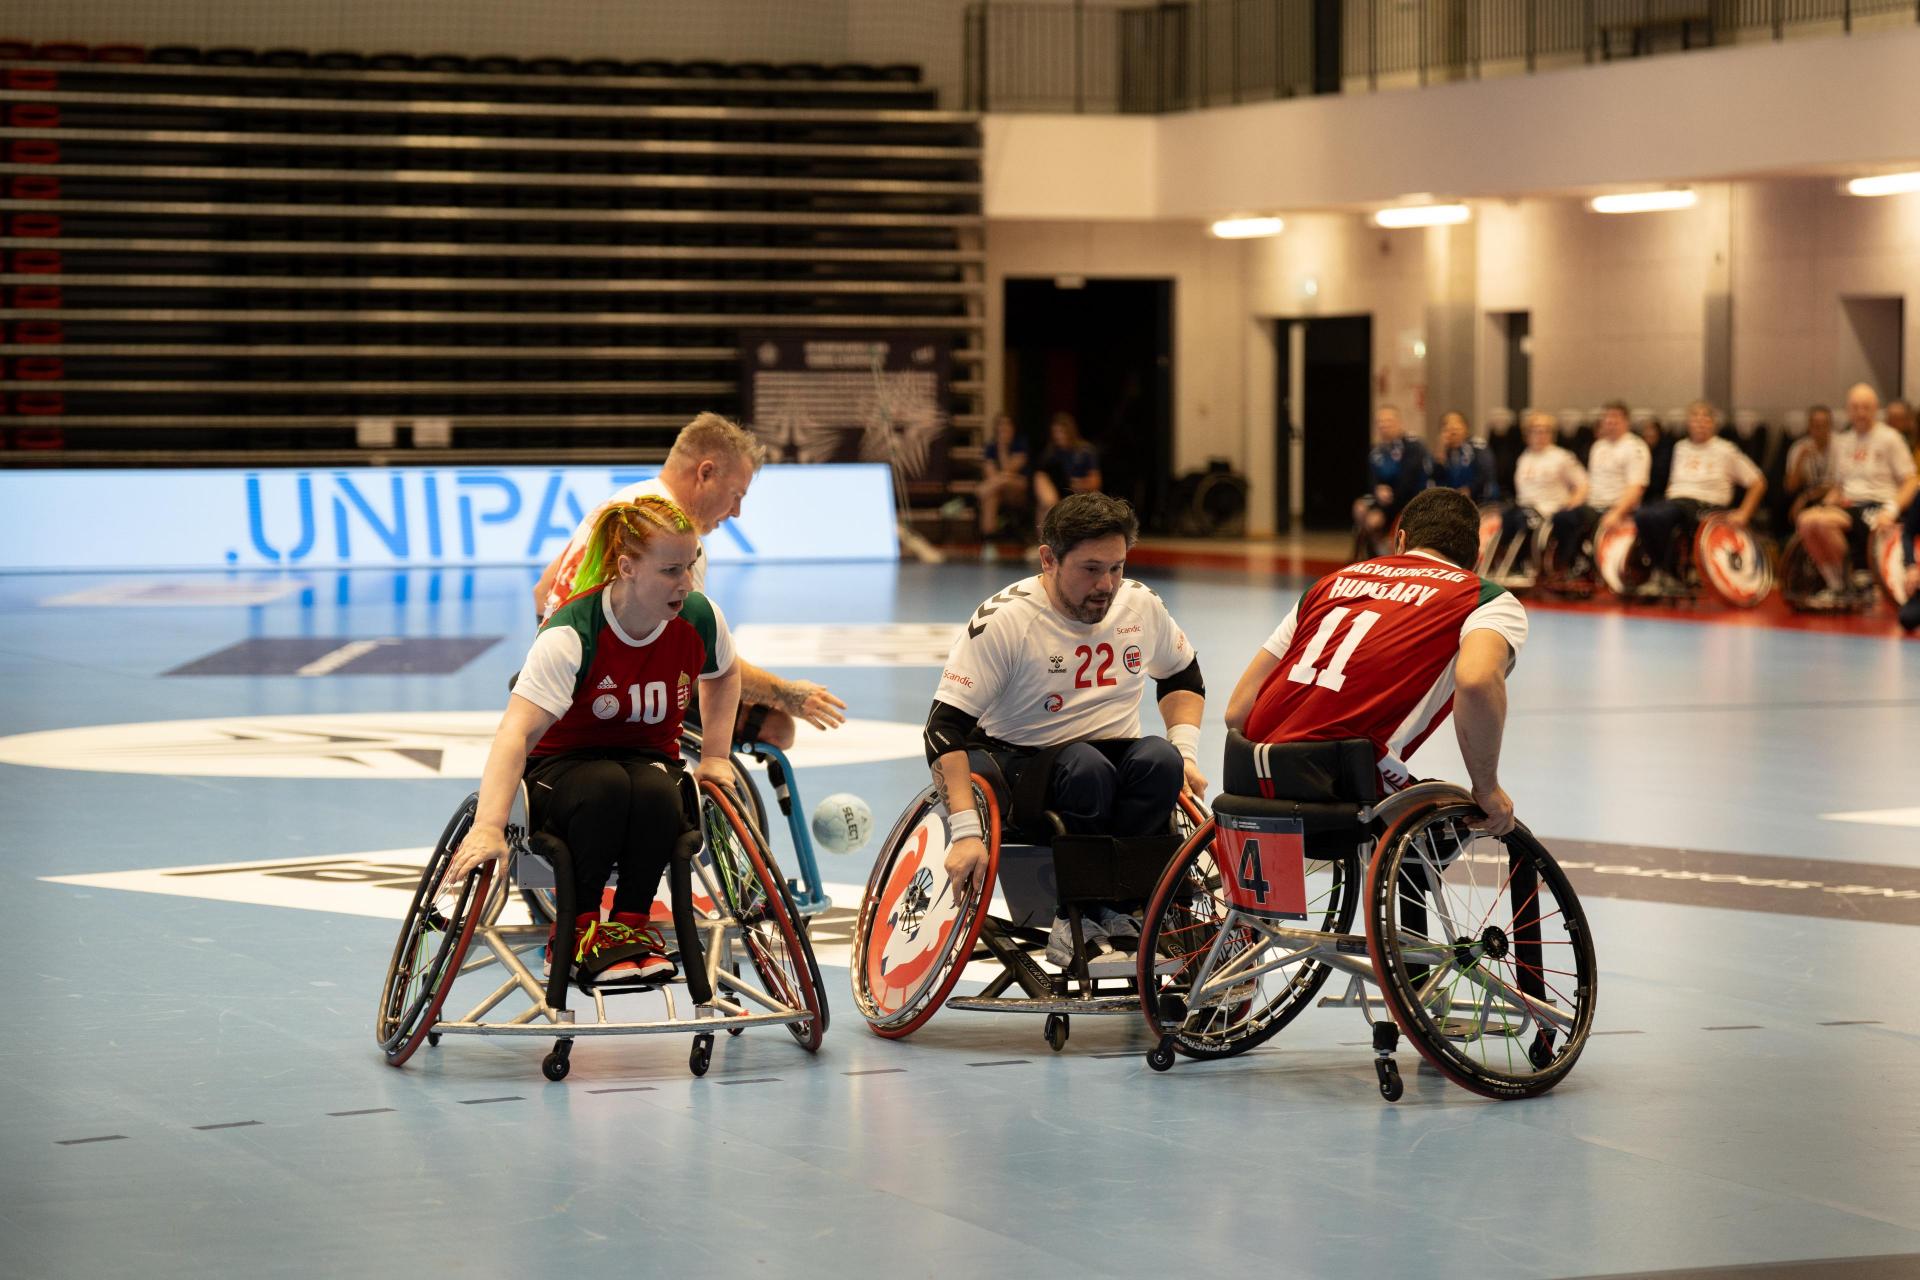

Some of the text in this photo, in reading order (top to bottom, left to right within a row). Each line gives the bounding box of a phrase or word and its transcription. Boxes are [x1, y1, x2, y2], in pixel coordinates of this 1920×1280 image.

[1328, 576, 1440, 606] HUNGARY
[1116, 624, 1141, 635] Scandic
[1075, 642, 1117, 689] 22
[1287, 606, 1382, 693] 11
[943, 669, 974, 688] Scandic
[624, 681, 668, 725] 10
[842, 806, 858, 840] SELECT
[1237, 838, 1270, 905] 4
